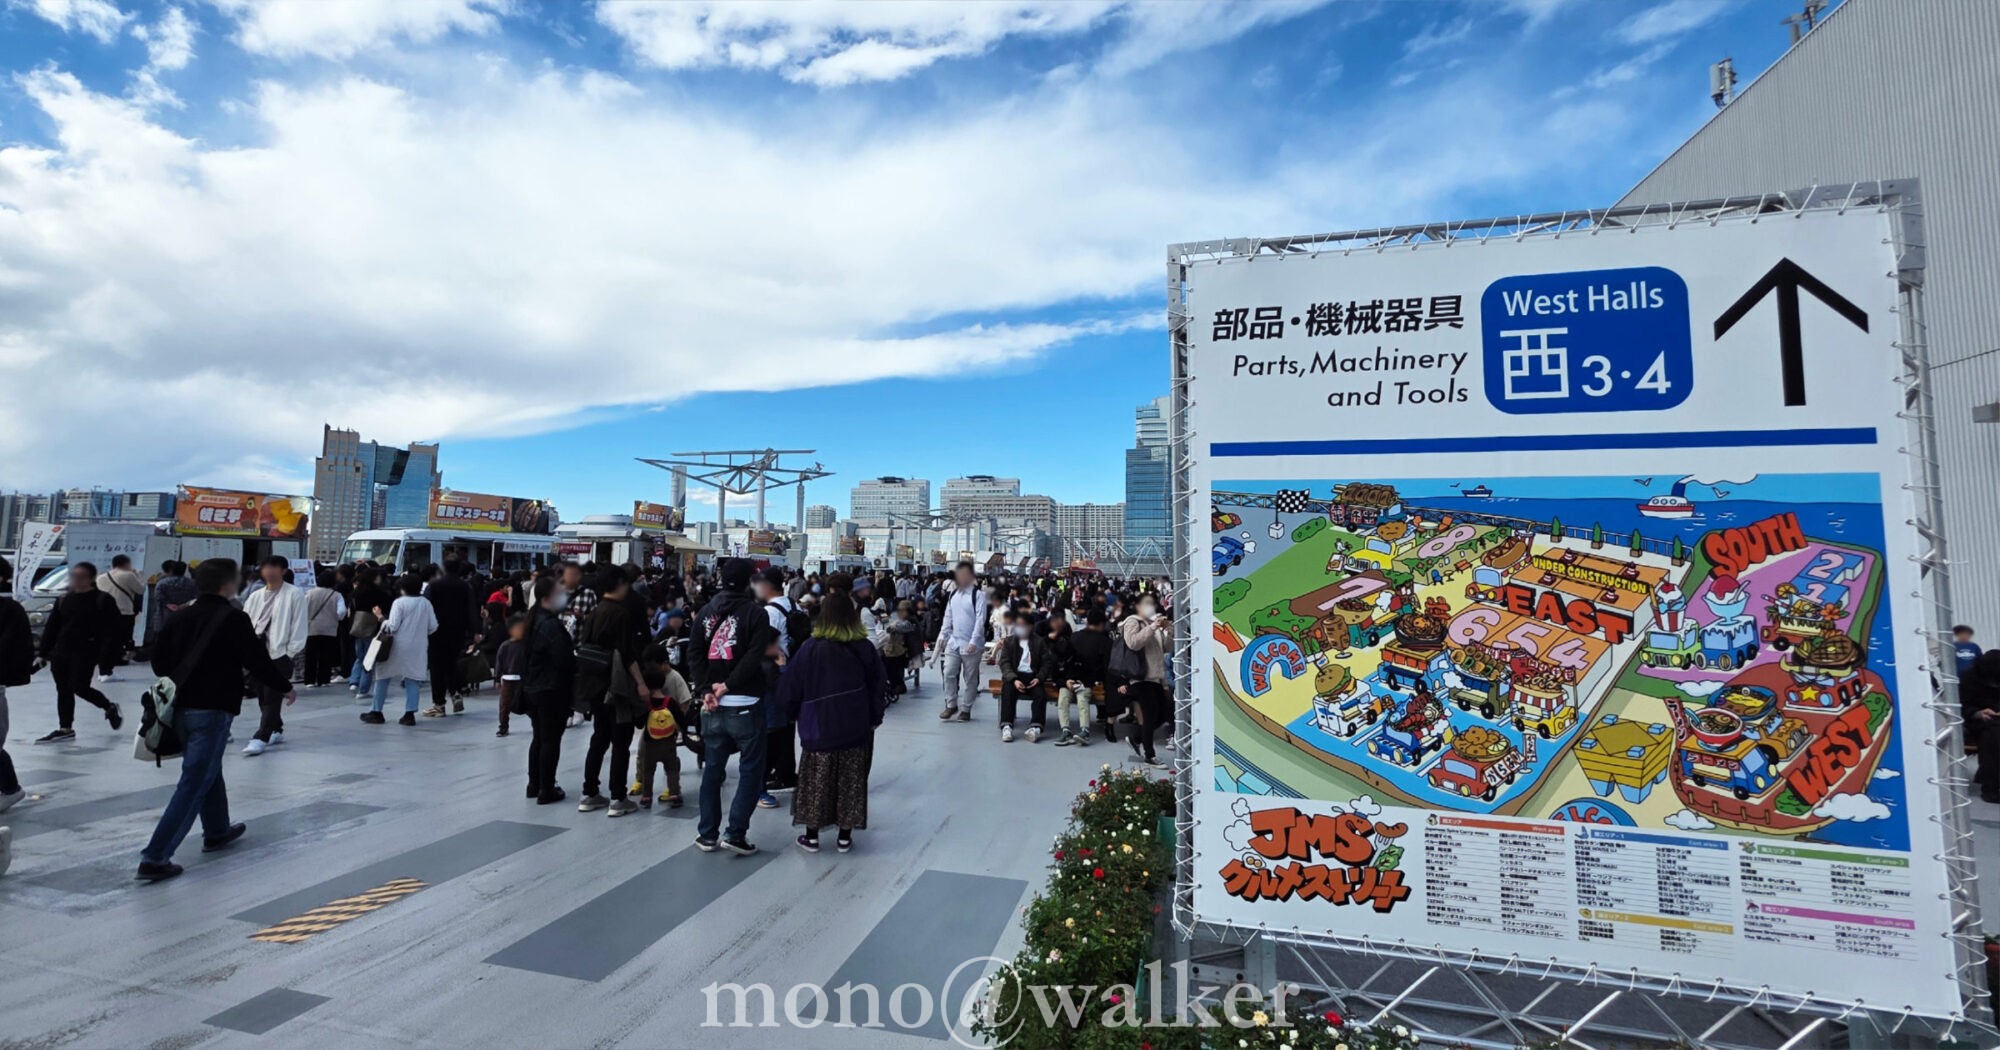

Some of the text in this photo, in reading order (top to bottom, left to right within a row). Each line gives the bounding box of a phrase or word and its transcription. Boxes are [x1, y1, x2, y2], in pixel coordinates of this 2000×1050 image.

[1212, 294, 1465, 342] 部品・機械器具
[1502, 281, 1665, 318] West Halls
[1500, 327, 1569, 400] 西
[1328, 377, 1470, 408] and Tools
[1418, 524, 1476, 559] 8
[1704, 512, 1808, 580] SOUTH
[1532, 556, 1648, 594] UNDER CONSTRUCTION
[1808, 553, 1846, 579] 2
[1506, 584, 1633, 644] EAST
[1801, 583, 1831, 605] 1
[1448, 609, 1592, 671] 6 5 4
[1252, 641, 1305, 692] WELCOME
[1667, 699, 1687, 741] ラーメン
[1788, 704, 1874, 805] WEST
[1249, 807, 1377, 867] JMS
